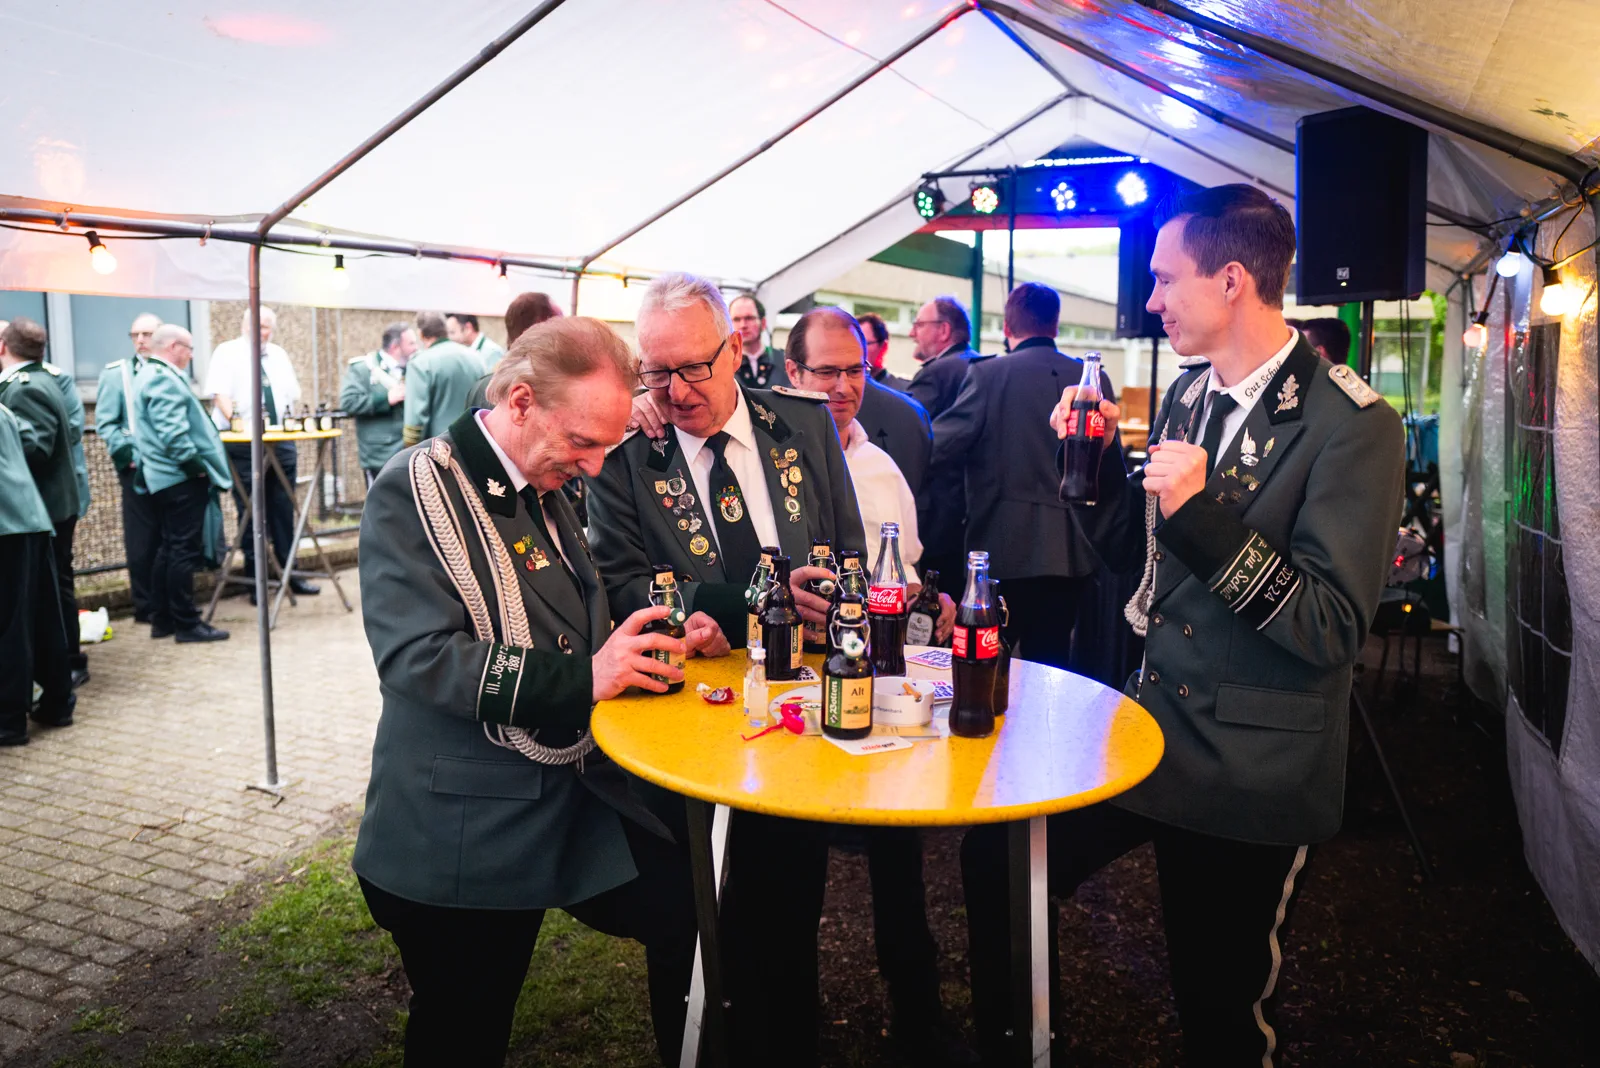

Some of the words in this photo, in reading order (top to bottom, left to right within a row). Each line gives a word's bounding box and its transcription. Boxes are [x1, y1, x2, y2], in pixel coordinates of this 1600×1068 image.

[1244, 382, 1261, 399] Gut
[1244, 547, 1263, 569] Gut
[1263, 563, 1294, 602] 023-24
[844, 608, 856, 616] Alt
[851, 687, 864, 697] Alt
